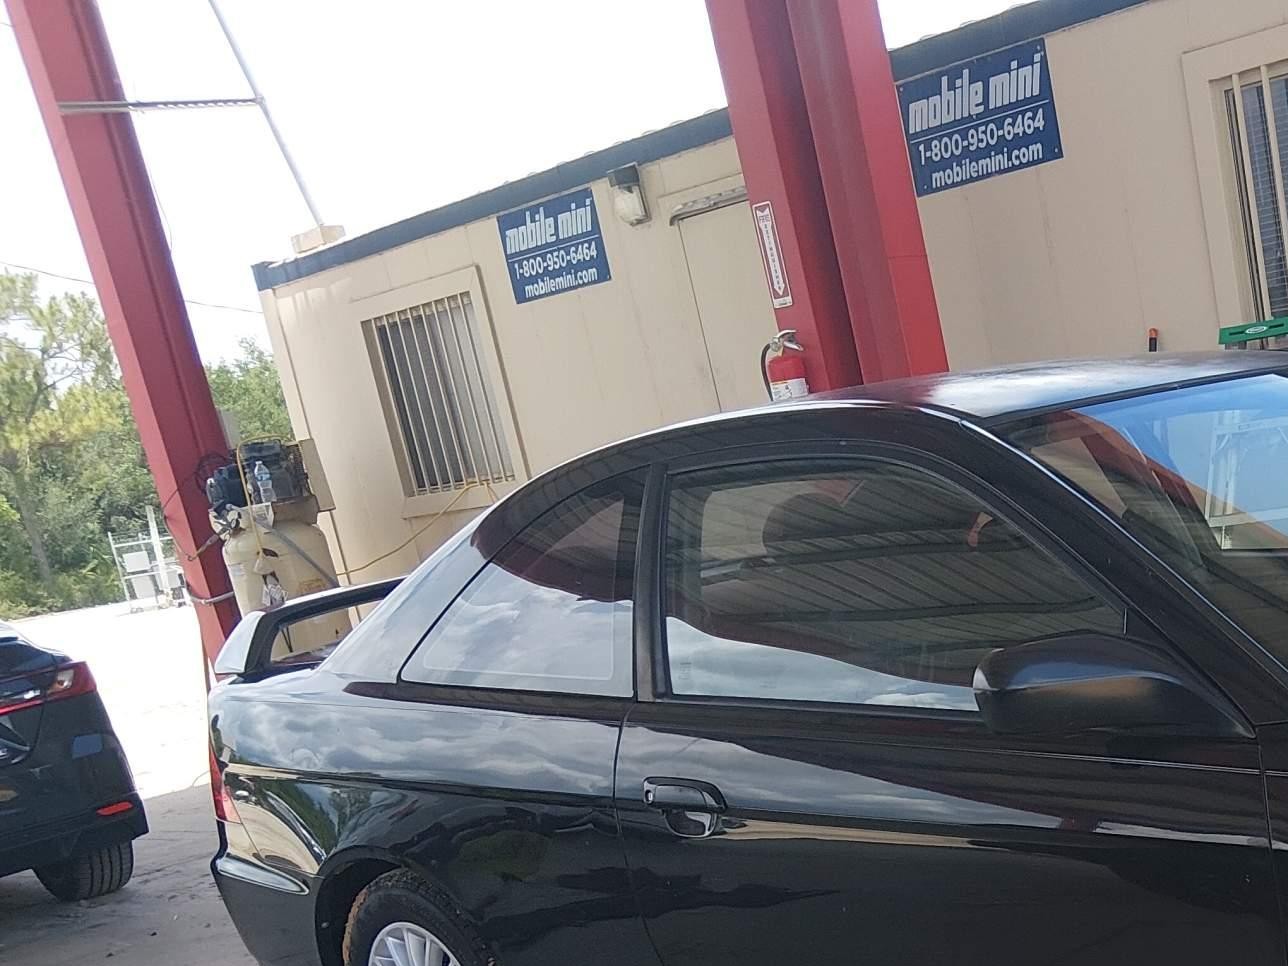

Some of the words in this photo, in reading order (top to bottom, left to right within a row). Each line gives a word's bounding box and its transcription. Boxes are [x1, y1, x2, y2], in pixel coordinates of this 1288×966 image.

[908, 68, 984, 134] mobile
[988, 52, 1041, 110] mini
[918, 107, 1045, 165] 1-800-950-6464
[931, 142, 1043, 189] mobilemini.com
[505, 206, 557, 255] mobile
[557, 198, 592, 240] mini
[514, 240, 598, 280] 1-800-950-6464
[524, 267, 598, 299] mobilemini.com
